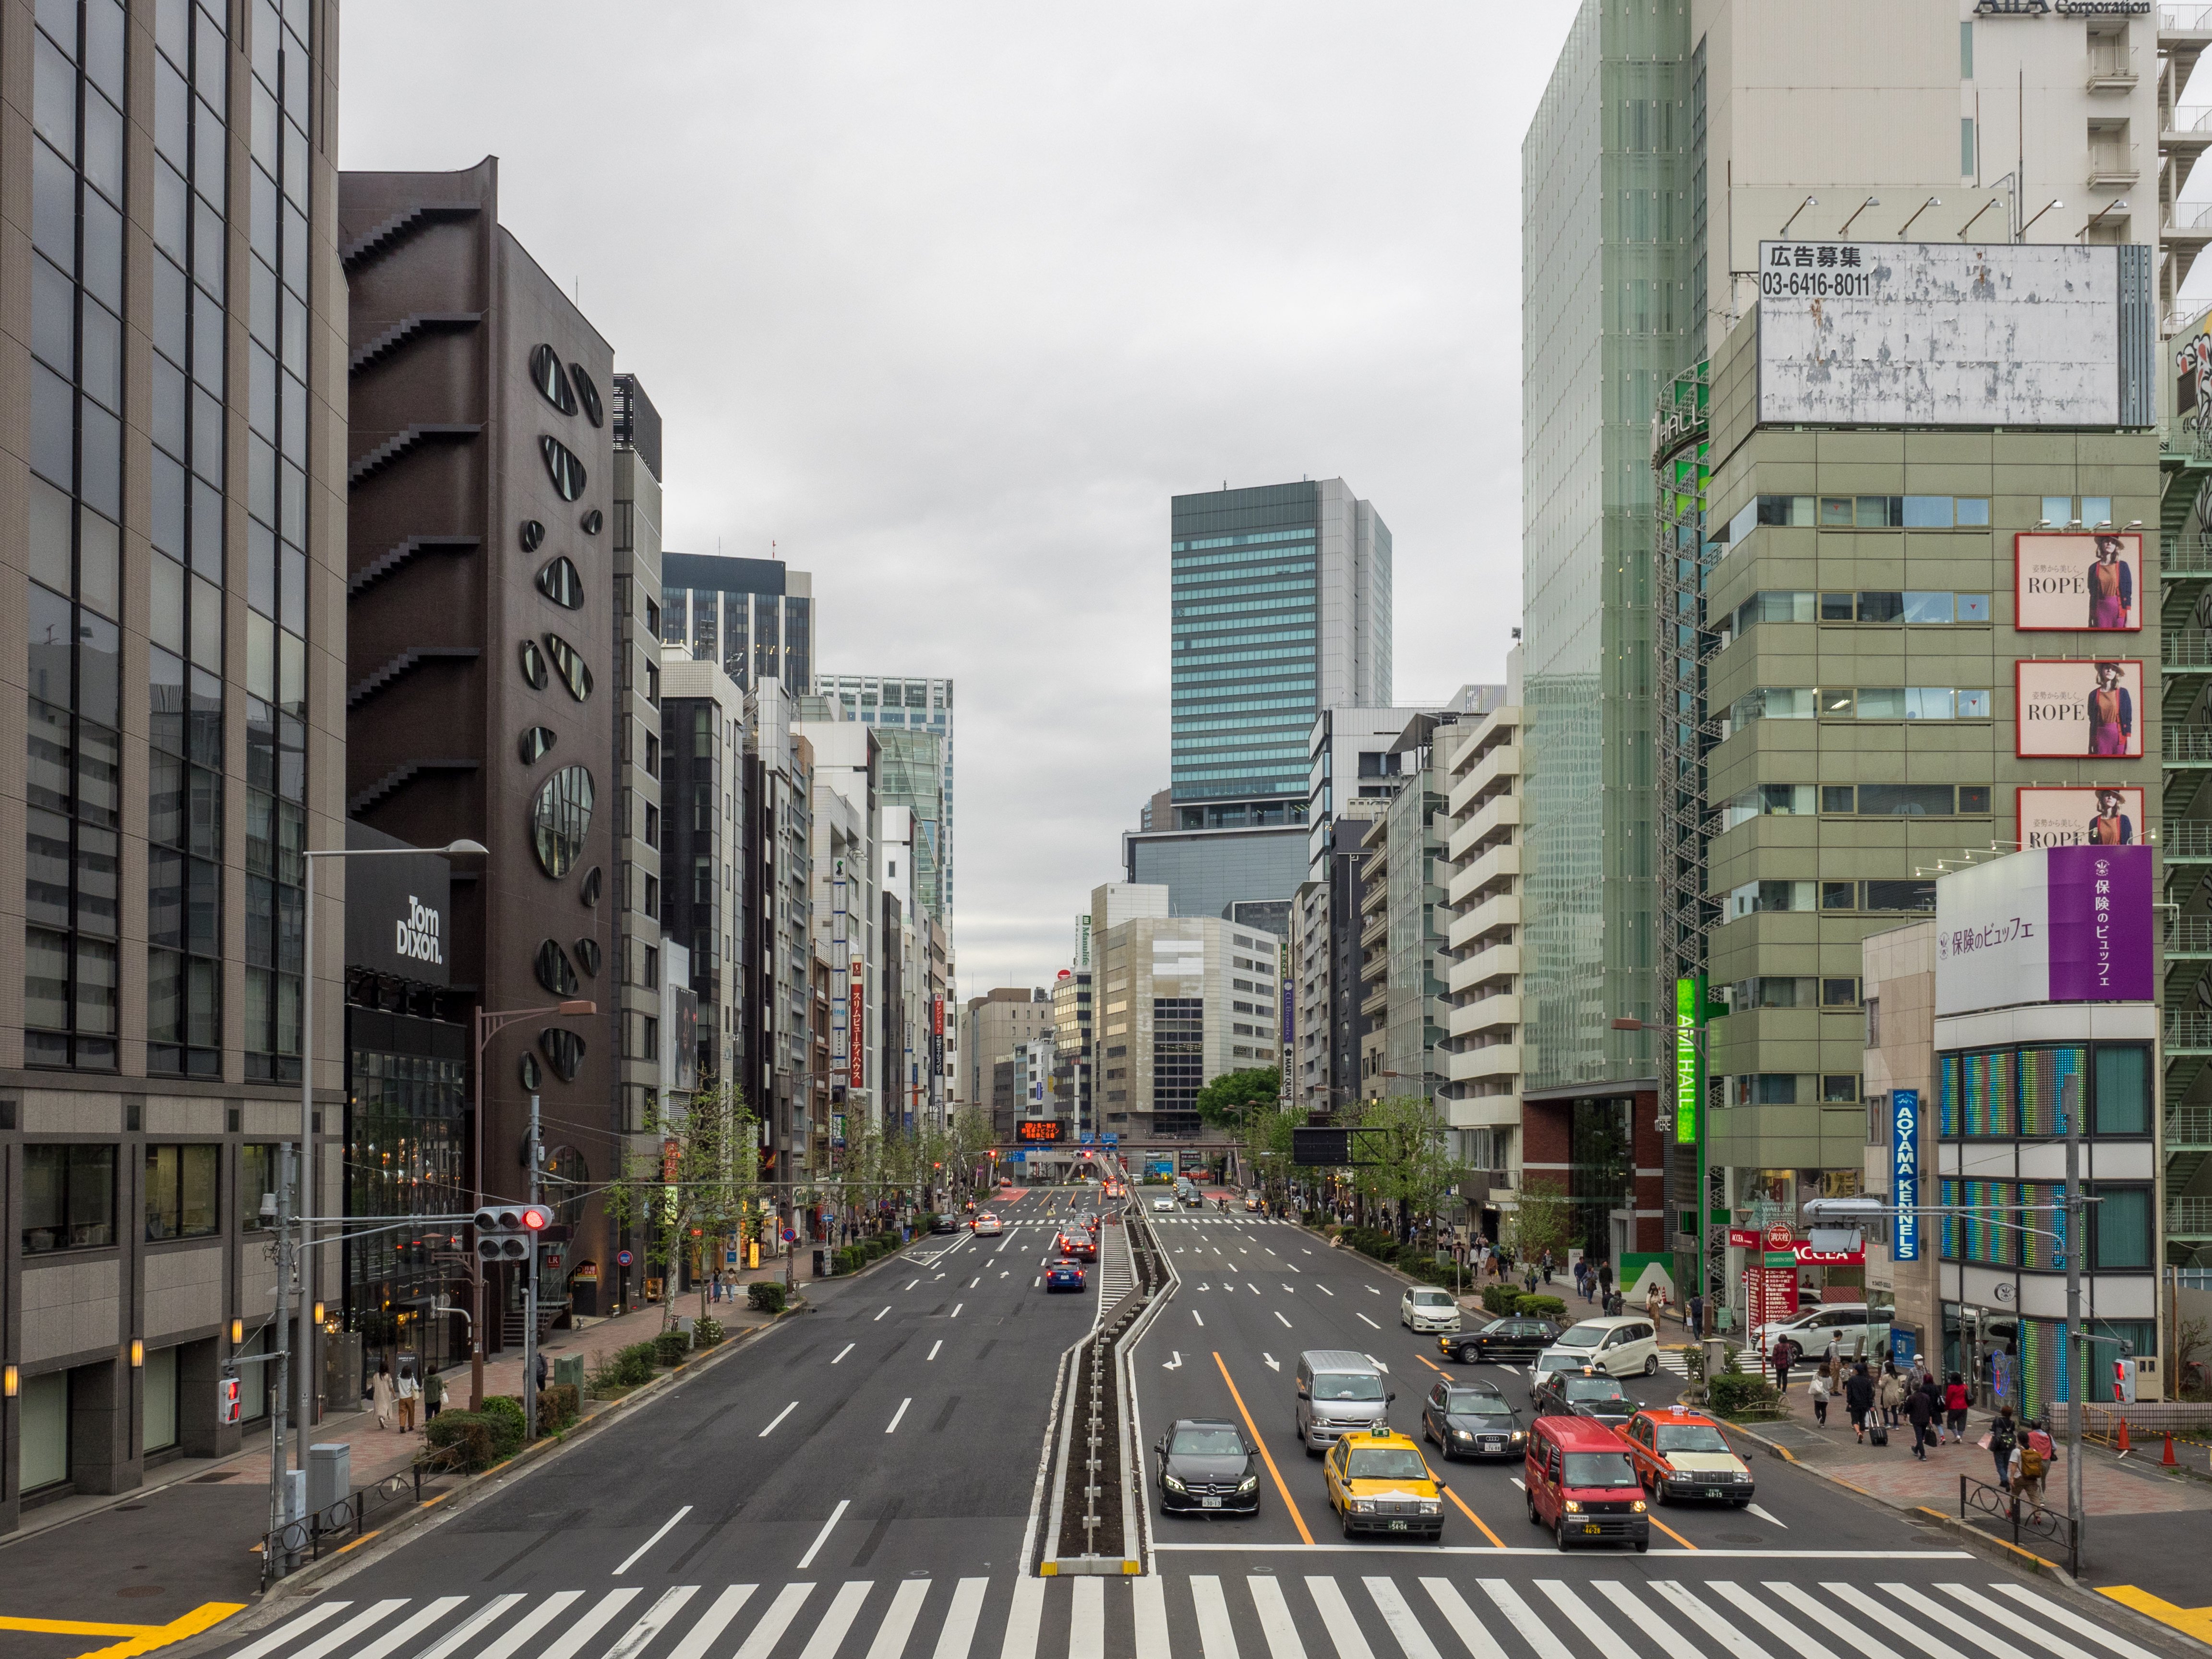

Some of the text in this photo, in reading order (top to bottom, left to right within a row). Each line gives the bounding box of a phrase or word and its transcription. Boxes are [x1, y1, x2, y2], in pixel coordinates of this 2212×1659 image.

[2055, 0, 2151, 17] Corporation
[1770, 246, 1861, 268] 広告募集
[1763, 272, 1869, 296] 03-6416-8011
[1952, 917, 2034, 956] 保険のビュッフェ
[2095, 880, 2110, 986] 保険のビュッフェ
[852, 993, 861, 1079] スリムビューティハウス
[1679, 1060, 1694, 1108] HALL
[1897, 1107, 1914, 1174] AOYAMA
[1732, 1234, 1743, 1242] ACCEA
[1770, 1232, 1789, 1241] 消火栓
[1898, 1180, 1913, 1258] KENNELS
